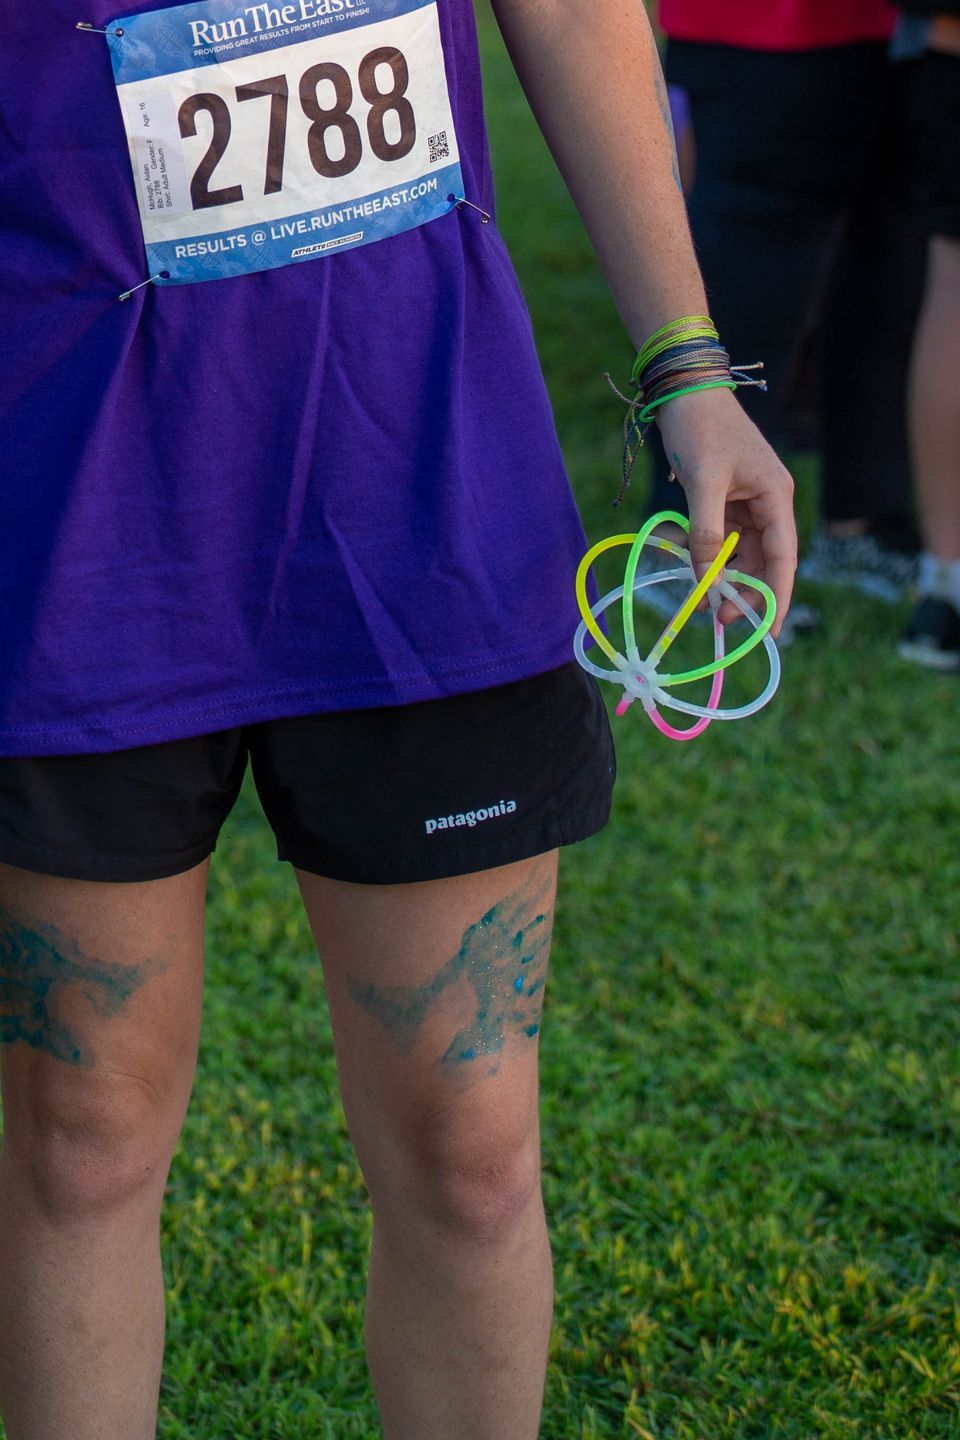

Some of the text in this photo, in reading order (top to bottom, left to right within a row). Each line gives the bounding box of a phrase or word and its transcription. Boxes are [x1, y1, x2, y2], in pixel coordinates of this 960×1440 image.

[188, 17, 249, 47] Run
[244, 2, 297, 33] The
[193, 42, 234, 56] PROVIDING
[234, 35, 258, 48] GREAT
[260, 27, 290, 41] RESULTS
[290, 22, 311, 34] FROM
[311, 16, 334, 28] START
[335, 13, 345, 22] TO
[177, 46, 417, 211] 2788
[175, 177, 439, 259] RESULTS @ LIVE.RUNTHEEAST.COM
[424, 799, 517, 834] patagonia
